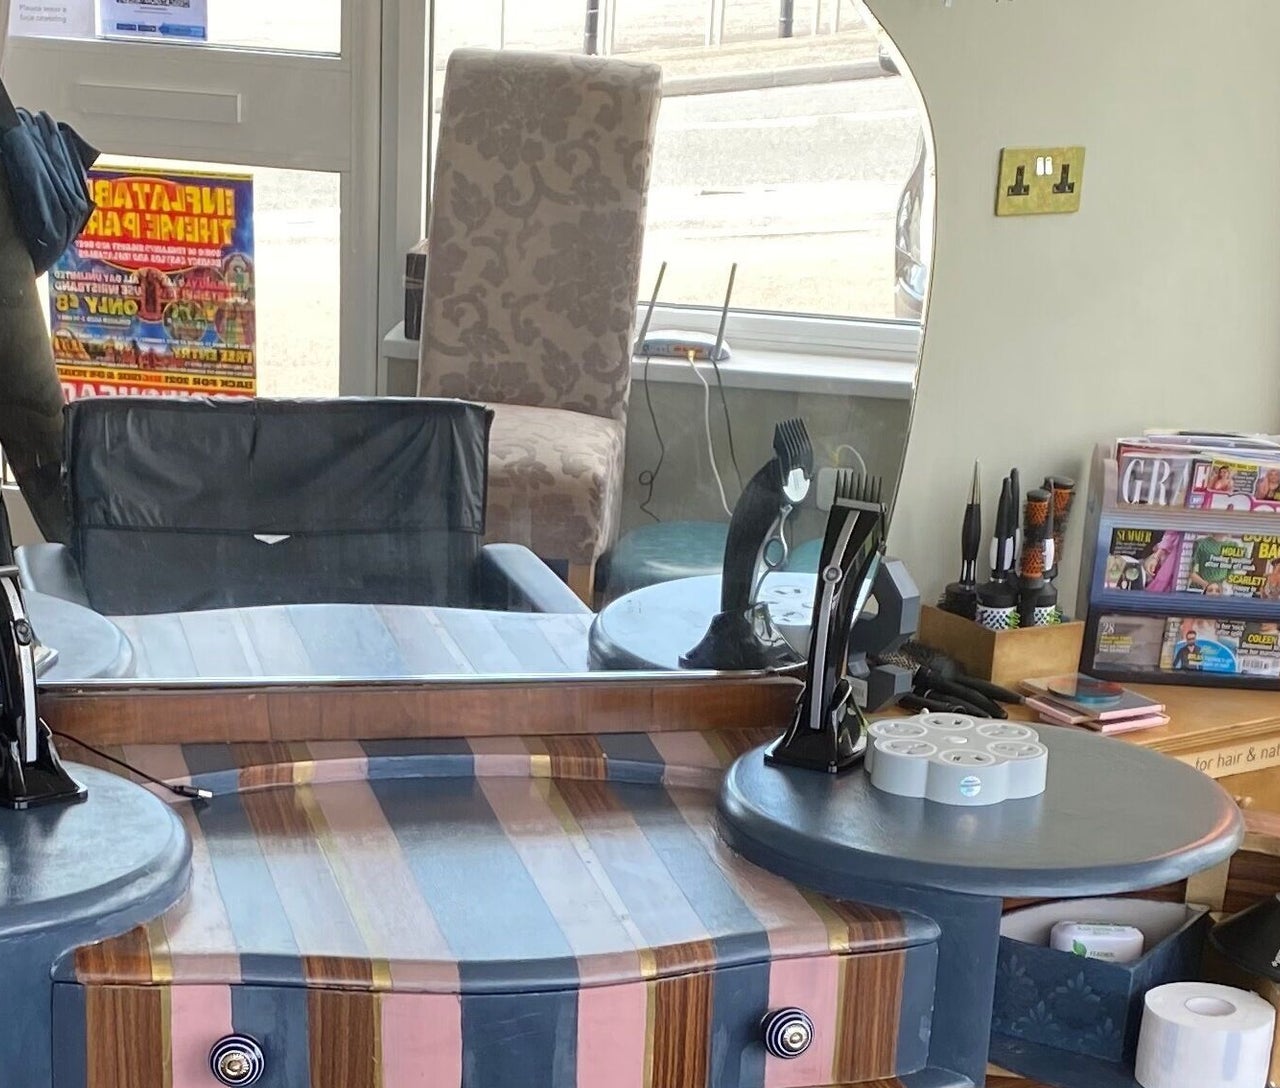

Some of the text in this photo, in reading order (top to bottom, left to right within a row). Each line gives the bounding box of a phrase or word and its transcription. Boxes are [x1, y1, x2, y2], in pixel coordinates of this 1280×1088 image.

[1117, 530, 1152, 543] SUMMER
[1221, 547, 1245, 557] MOLLY
[1228, 575, 1266, 585] SCARLETT
[1102, 622, 1115, 634] 28
[1248, 634, 1278, 644] COLEEN
[1195, 757, 1213, 772] for
[1217, 751, 1241, 768] hair
[1246, 748, 1256, 762] &
